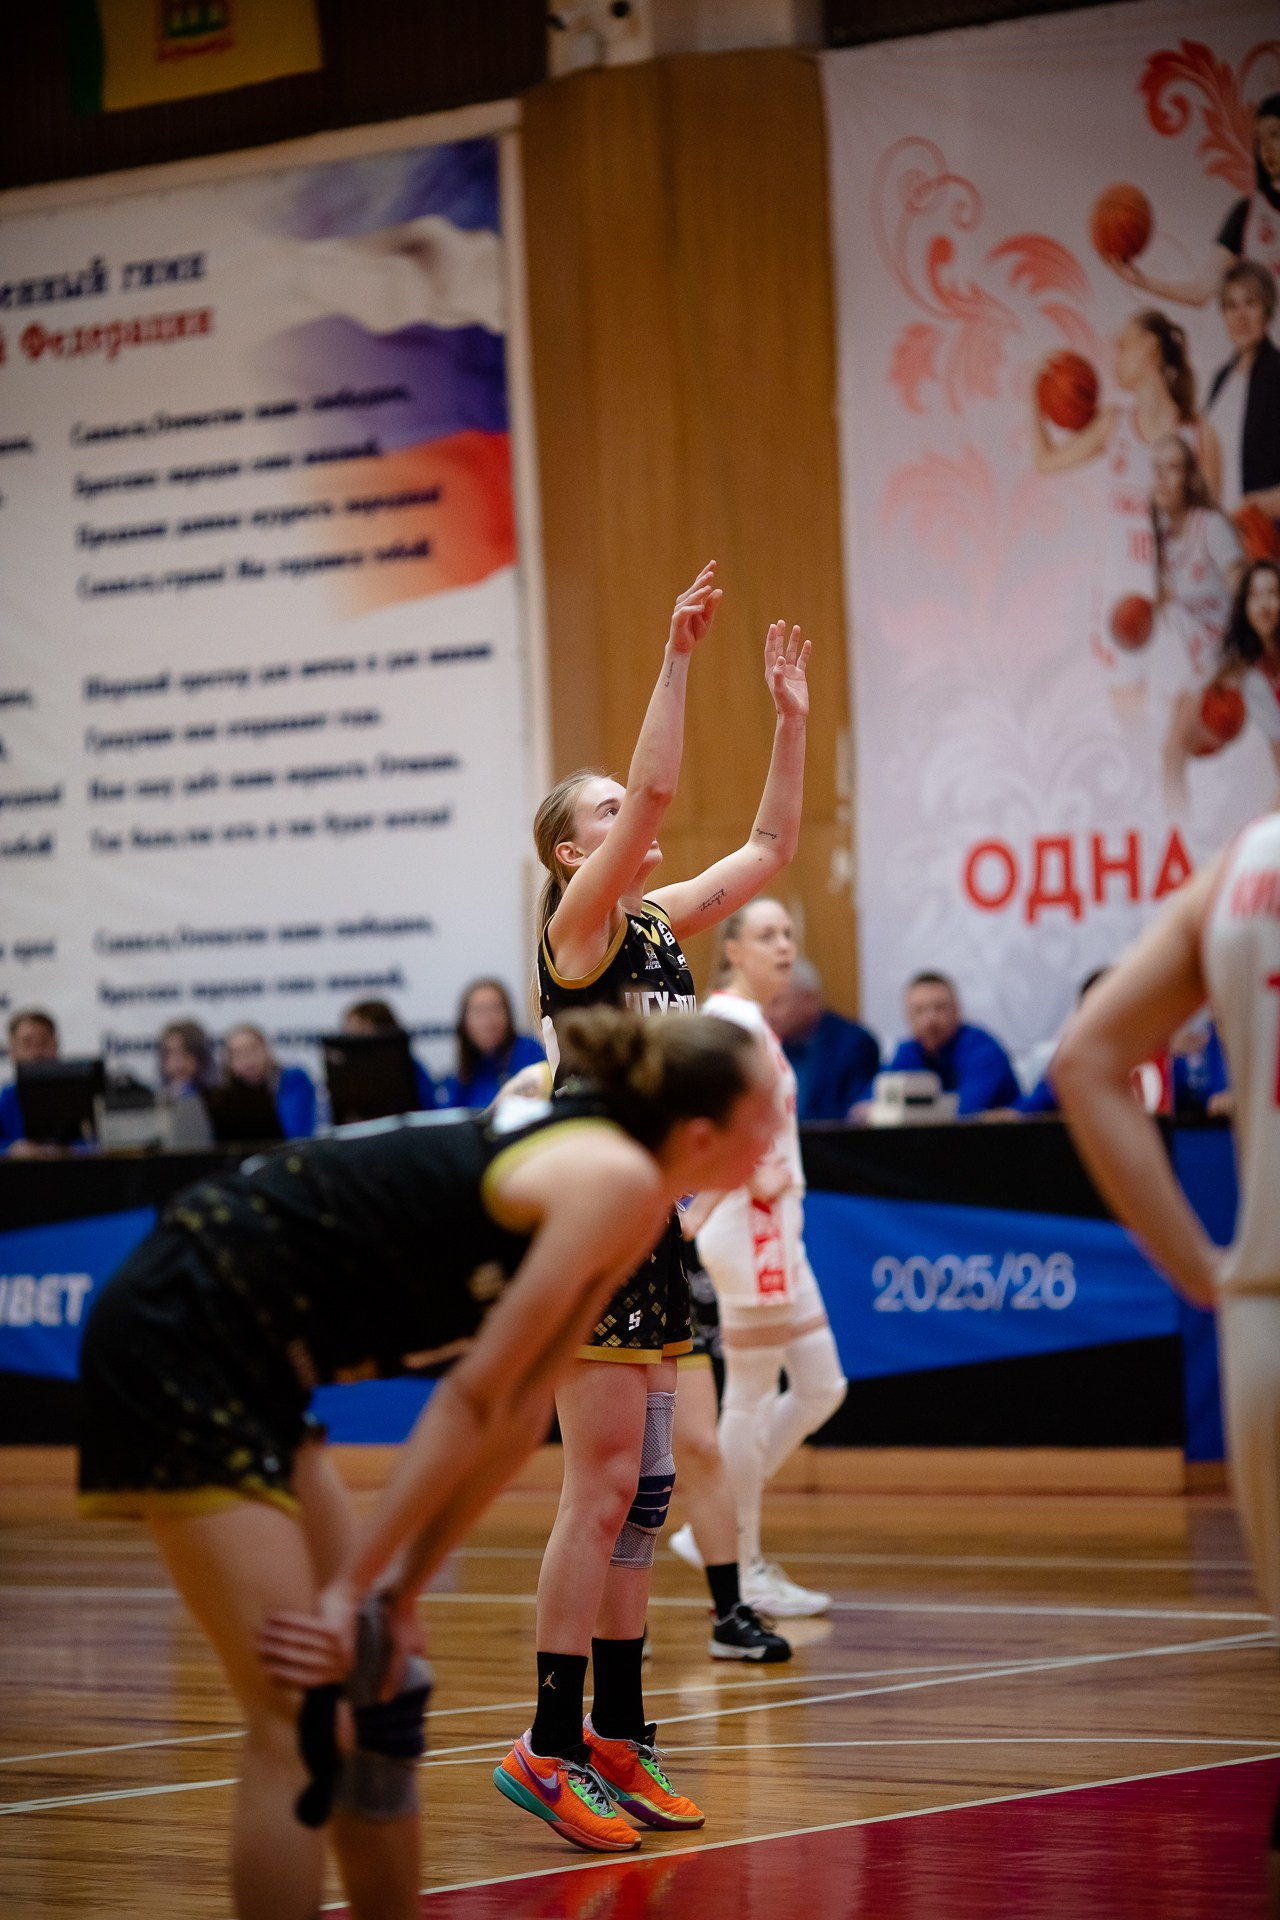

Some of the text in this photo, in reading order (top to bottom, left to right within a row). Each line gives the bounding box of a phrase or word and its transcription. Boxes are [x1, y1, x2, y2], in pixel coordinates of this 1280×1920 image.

[962, 827, 1194, 925] ОДНА
[0, 1272, 94, 1328] BET
[871, 1250, 1078, 1314] 2025/26
